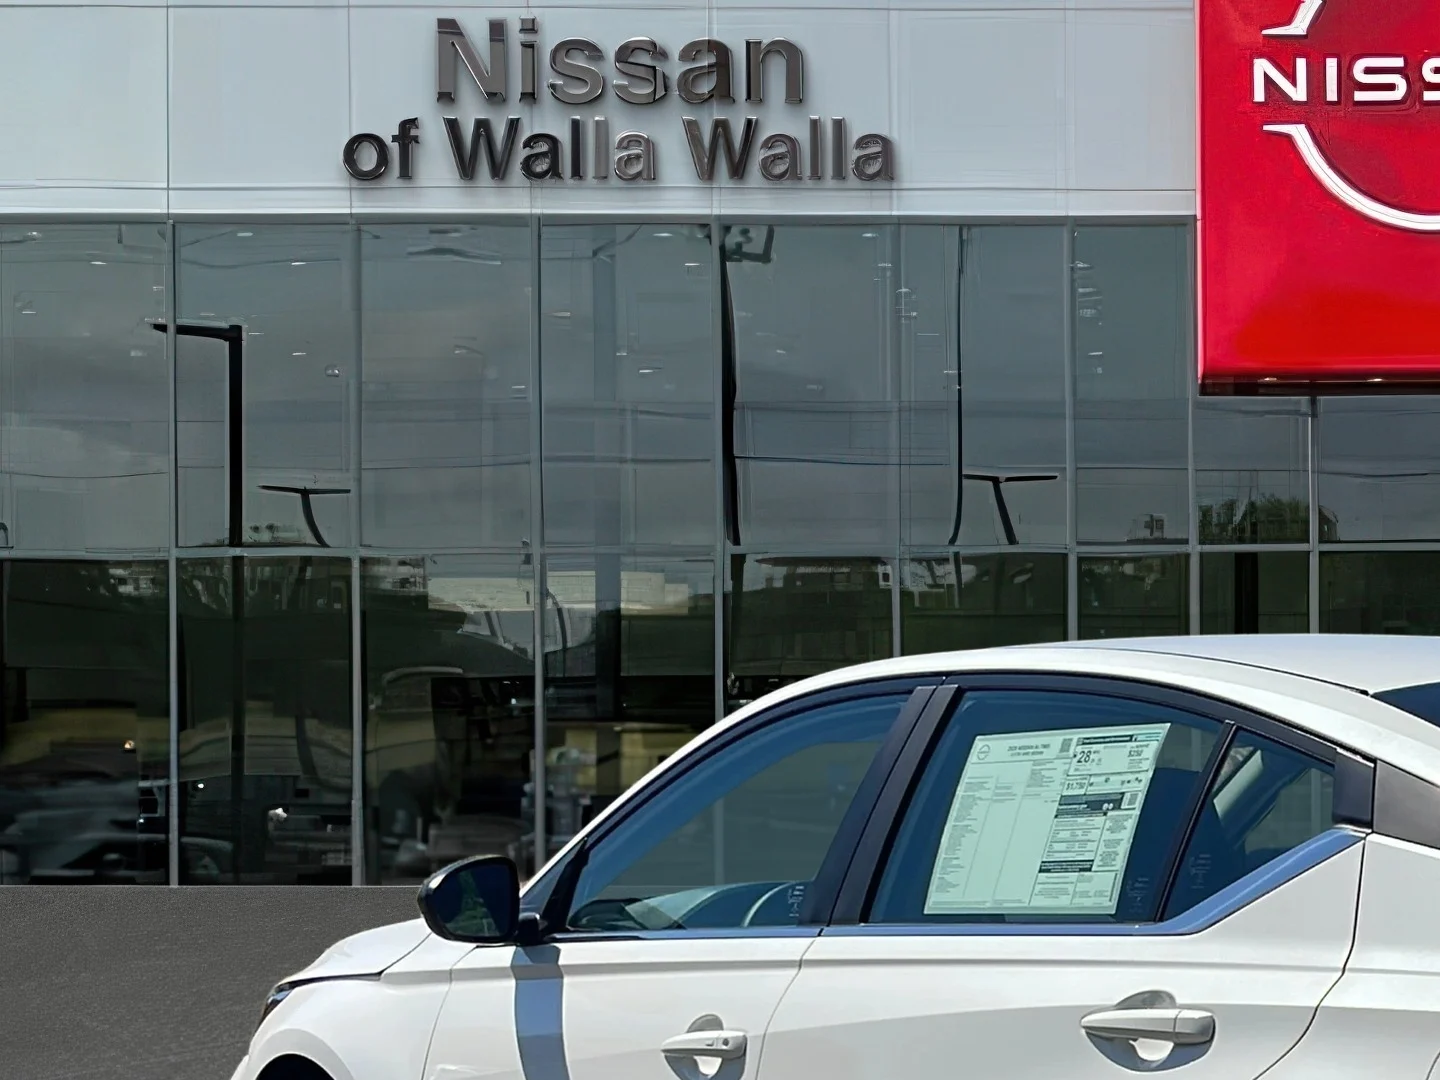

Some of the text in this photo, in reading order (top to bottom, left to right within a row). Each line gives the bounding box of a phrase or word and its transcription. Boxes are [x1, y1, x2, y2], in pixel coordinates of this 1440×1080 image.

[435, 16, 804, 103] Nissan
[342, 116, 894, 181] of Walla Walla
[1076, 750, 1092, 763] 28
